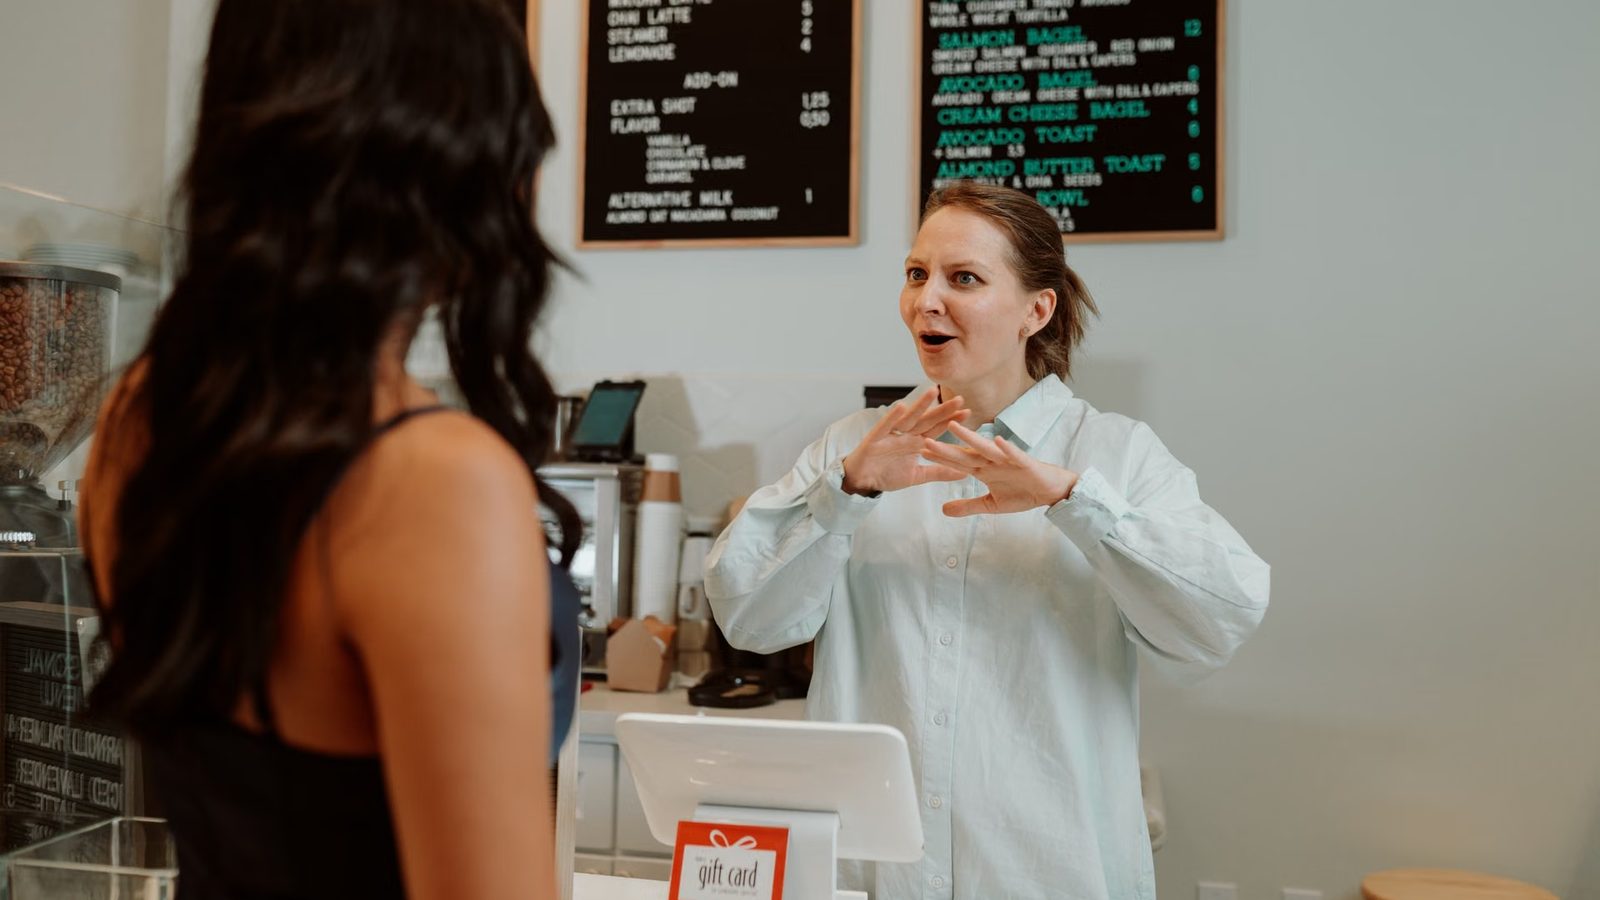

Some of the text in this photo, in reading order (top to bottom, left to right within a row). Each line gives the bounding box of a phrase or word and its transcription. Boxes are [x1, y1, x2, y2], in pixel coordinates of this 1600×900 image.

[647, 6, 692, 25] LATTE
[929, 9, 1068, 28] WHOLE WHEAT TORTILLA
[607, 26, 668, 45] STEAMER
[801, 18, 813, 35] 2
[800, 36, 812, 53] 4
[938, 25, 1087, 49] SALMON BAGEL
[609, 43, 676, 63] LEMONADE
[932, 37, 1175, 62] SMOKED SALMON CUCUMBER RED ONION
[931, 61, 972, 75] CREAM
[974, 59, 1018, 73] CHEESE
[1021, 57, 1049, 71] WITH
[1090, 52, 1136, 67] CAPERS
[683, 71, 738, 89] ADD-ON
[938, 70, 1098, 93] AVOCADO BAGEL
[931, 92, 984, 106] AVOCADO
[991, 90, 1030, 104] CREAM
[1036, 88, 1080, 102] CHEESE
[1083, 85, 1114, 99] WITH
[611, 97, 697, 116] EXTRA SHOT
[937, 101, 1150, 126] CREAM CHEESE BAGEL
[611, 116, 660, 134] FLAVOR
[646, 134, 691, 147] VANILLA
[937, 124, 1098, 148] AVOCADO TOAST
[646, 145, 706, 159] CHOCOLATE
[945, 145, 992, 159] SALMON
[646, 157, 700, 171] CINNAMON
[711, 155, 746, 170] CLOVE
[937, 154, 1166, 178] ALMOND BUTTER TOAST
[646, 171, 693, 184] CARAMEL
[1063, 172, 1102, 187] SEEDS
[608, 190, 733, 208] ALTERNATIVE MILK
[1036, 189, 1089, 207] BOWL
[606, 209, 647, 224] ALMOND
[649, 208, 668, 223] OAT
[670, 207, 727, 222] MACADAMIA
[699, 857, 758, 890] gift card
